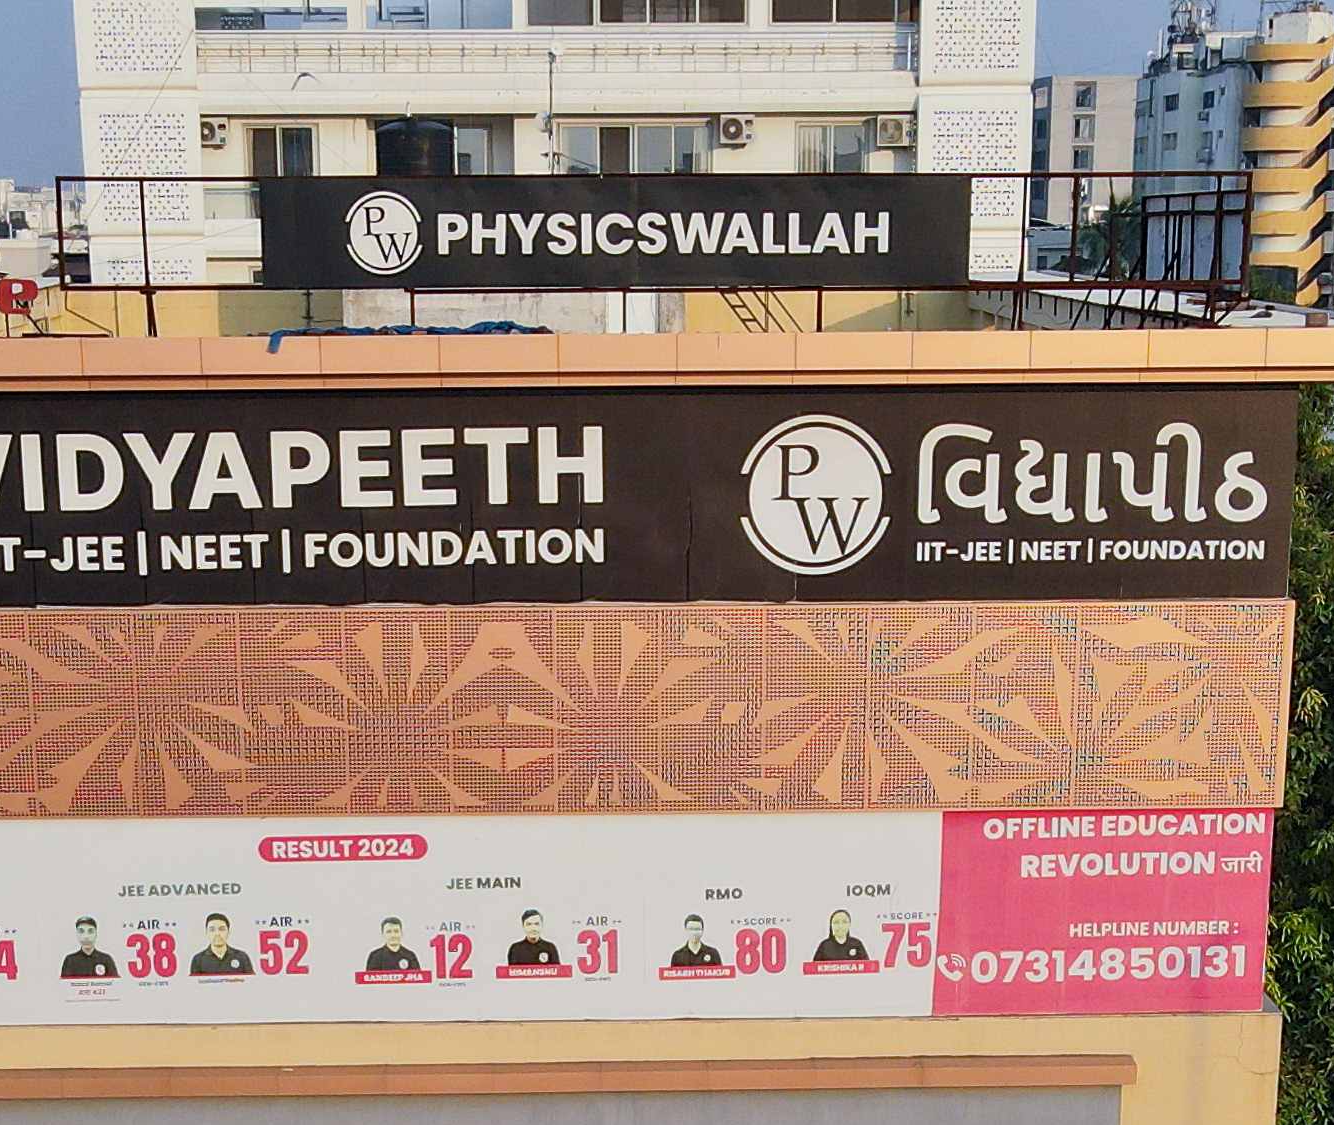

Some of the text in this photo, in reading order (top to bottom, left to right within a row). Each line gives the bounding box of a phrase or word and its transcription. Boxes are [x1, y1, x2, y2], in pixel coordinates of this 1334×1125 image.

[437, 211, 891, 257] PHYSICSWALLAH
[160, 533, 269, 570] NEET
[304, 528, 605, 567] FOUNDATION
[916, 540, 1266, 562] IIT-JEE NEET FOUNDATION
[983, 813, 1266, 840] OFFLINE EDUCATION
[271, 838, 414, 859] RESULT 2024
[1020, 851, 1264, 879] REVOLUTION जारी
[118, 882, 242, 897] JEE ADVANCED
[447, 876, 522, 890] JEE MAIN
[705, 887, 743, 901] RMO
[846, 883, 891, 898] IOQM
[137, 919, 161, 930] AIR
[269, 916, 293, 927] AIR
[439, 921, 462, 933] AIR
[586, 916, 609, 927] AIR
[1069, 921, 1229, 937] HELPLINE NUMBER
[127, 933, 177, 977] 38
[259, 930, 309, 974] 52
[429, 934, 473, 979] 12
[576, 930, 618, 973] 31
[735, 928, 786, 974] 80
[881, 922, 931, 968] 75
[970, 945, 1246, 983] 07314850131
